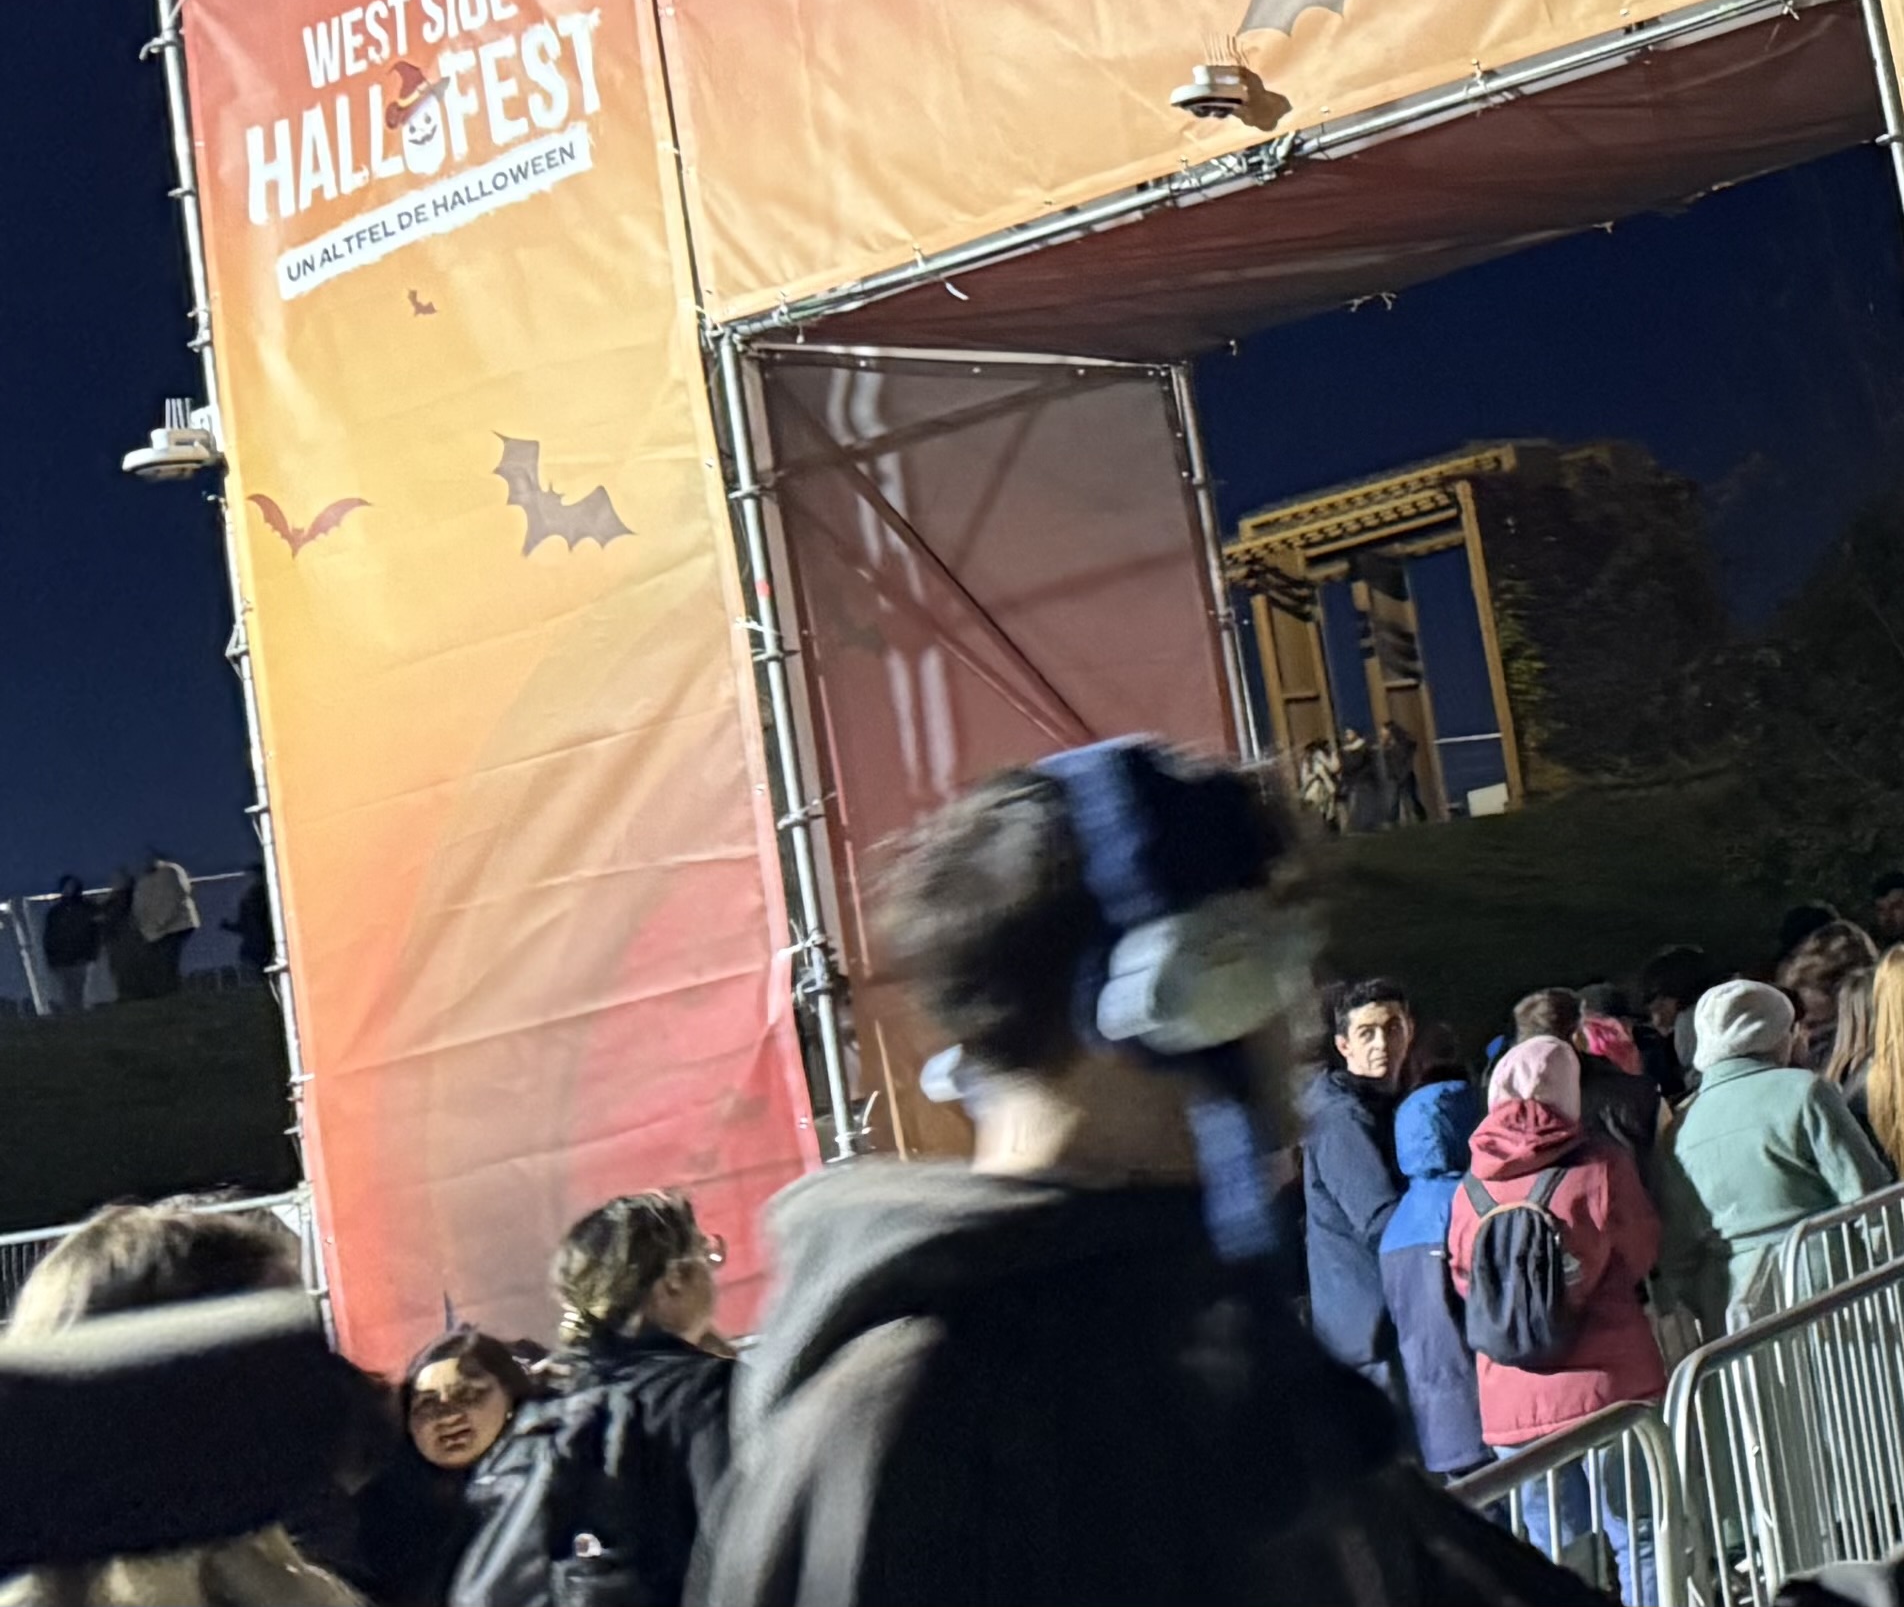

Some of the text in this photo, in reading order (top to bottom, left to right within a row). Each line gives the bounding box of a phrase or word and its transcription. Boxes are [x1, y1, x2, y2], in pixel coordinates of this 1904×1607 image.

[286, 141, 576, 283] UN ALTFEL DE HALLOWEEN
